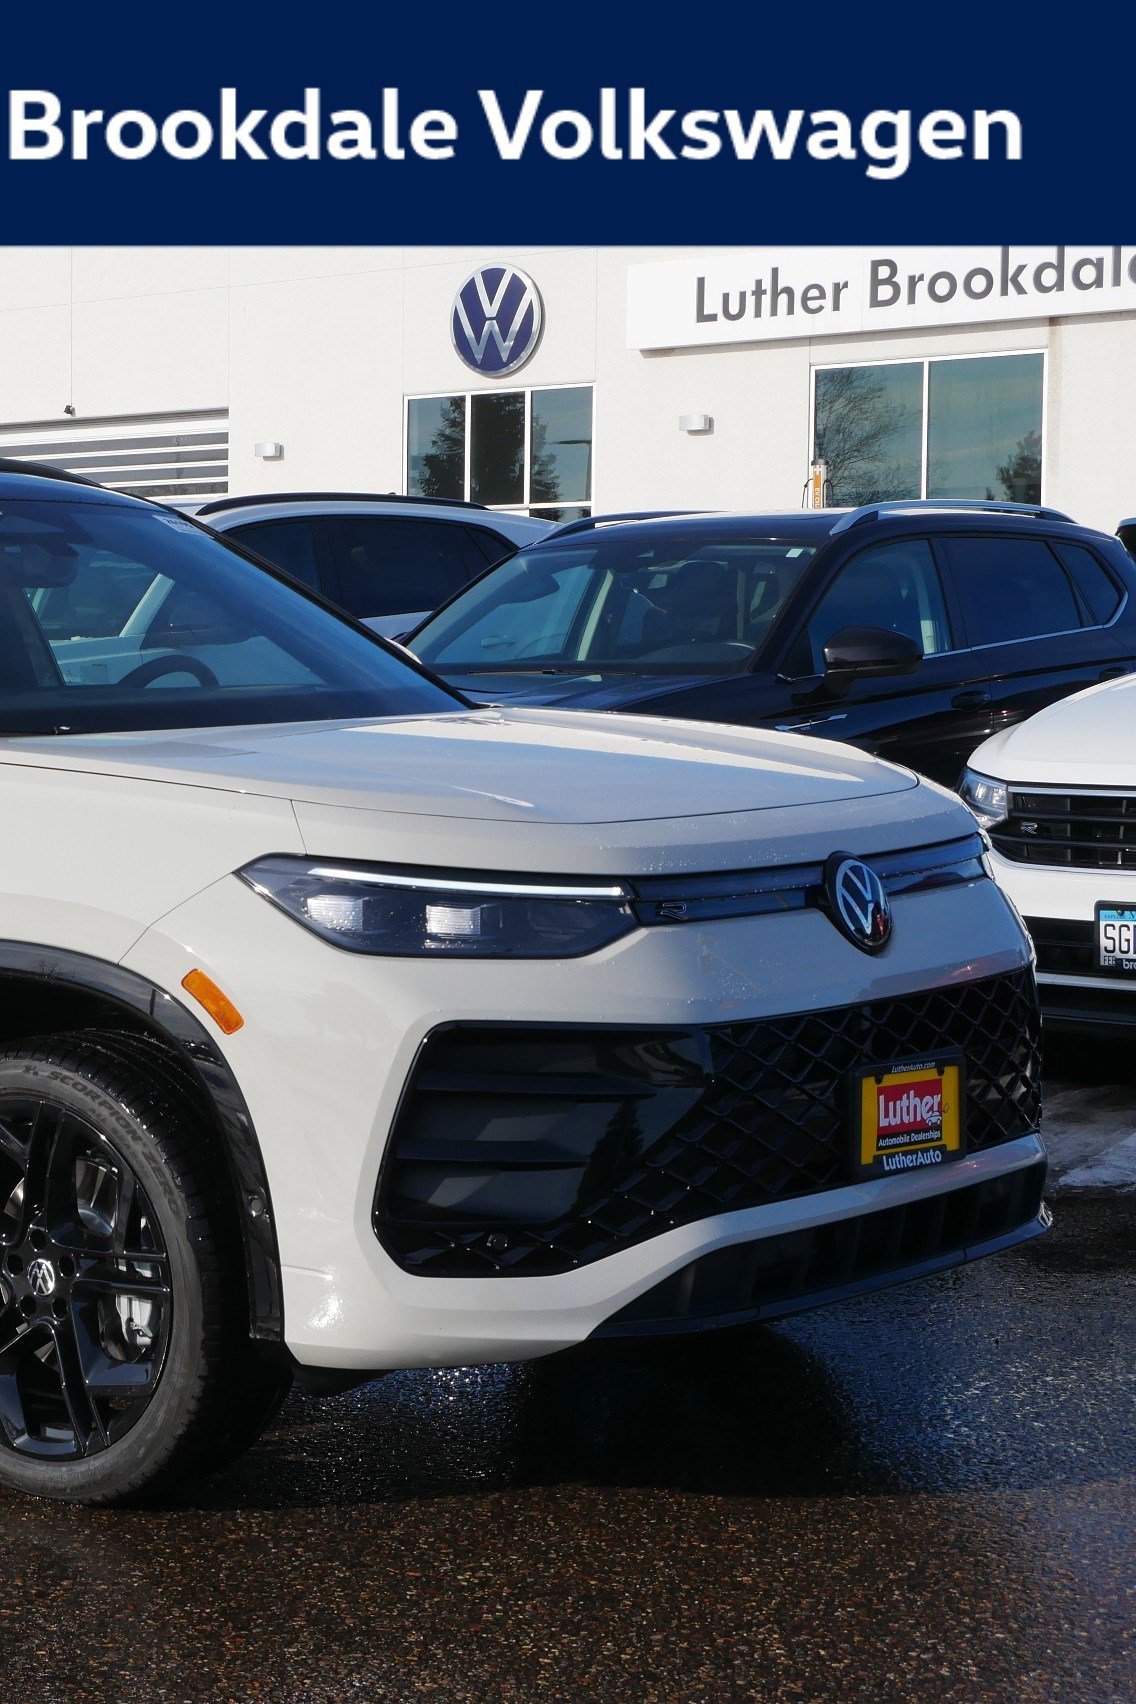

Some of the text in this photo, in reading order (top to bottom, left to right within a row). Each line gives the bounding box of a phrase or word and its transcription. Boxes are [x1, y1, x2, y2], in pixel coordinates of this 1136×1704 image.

[695, 244, 1136, 324] Luther Brookdal
[1104, 923, 1136, 955] SG
[891, 1061, 936, 1074] LutherAuto.com
[46, 1070, 143, 1142] SCORPION
[879, 1089, 942, 1128] Luther
[878, 1130, 941, 1147] Automobile Dealerships
[882, 1148, 942, 1171] LutherAuto
